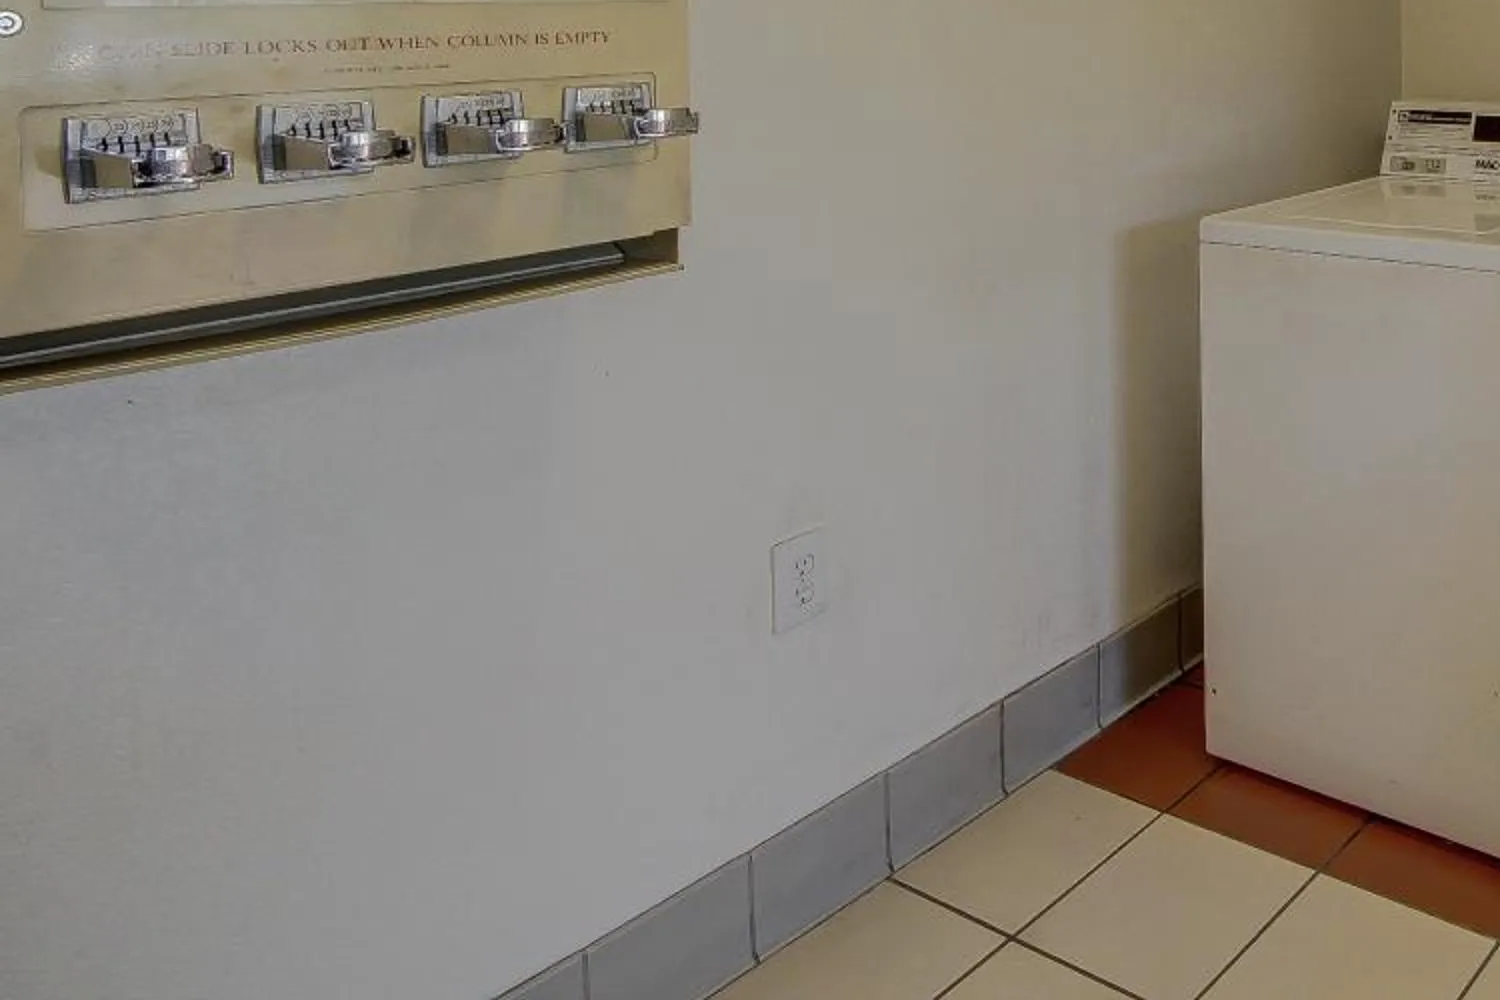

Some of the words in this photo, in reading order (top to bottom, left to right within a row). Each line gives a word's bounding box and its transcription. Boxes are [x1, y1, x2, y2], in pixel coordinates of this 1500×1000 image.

[245, 39, 318, 56] LOCKS
[379, 34, 440, 50] WHEN
[535, 32, 549, 46] IS
[555, 30, 611, 46] EMPTY
